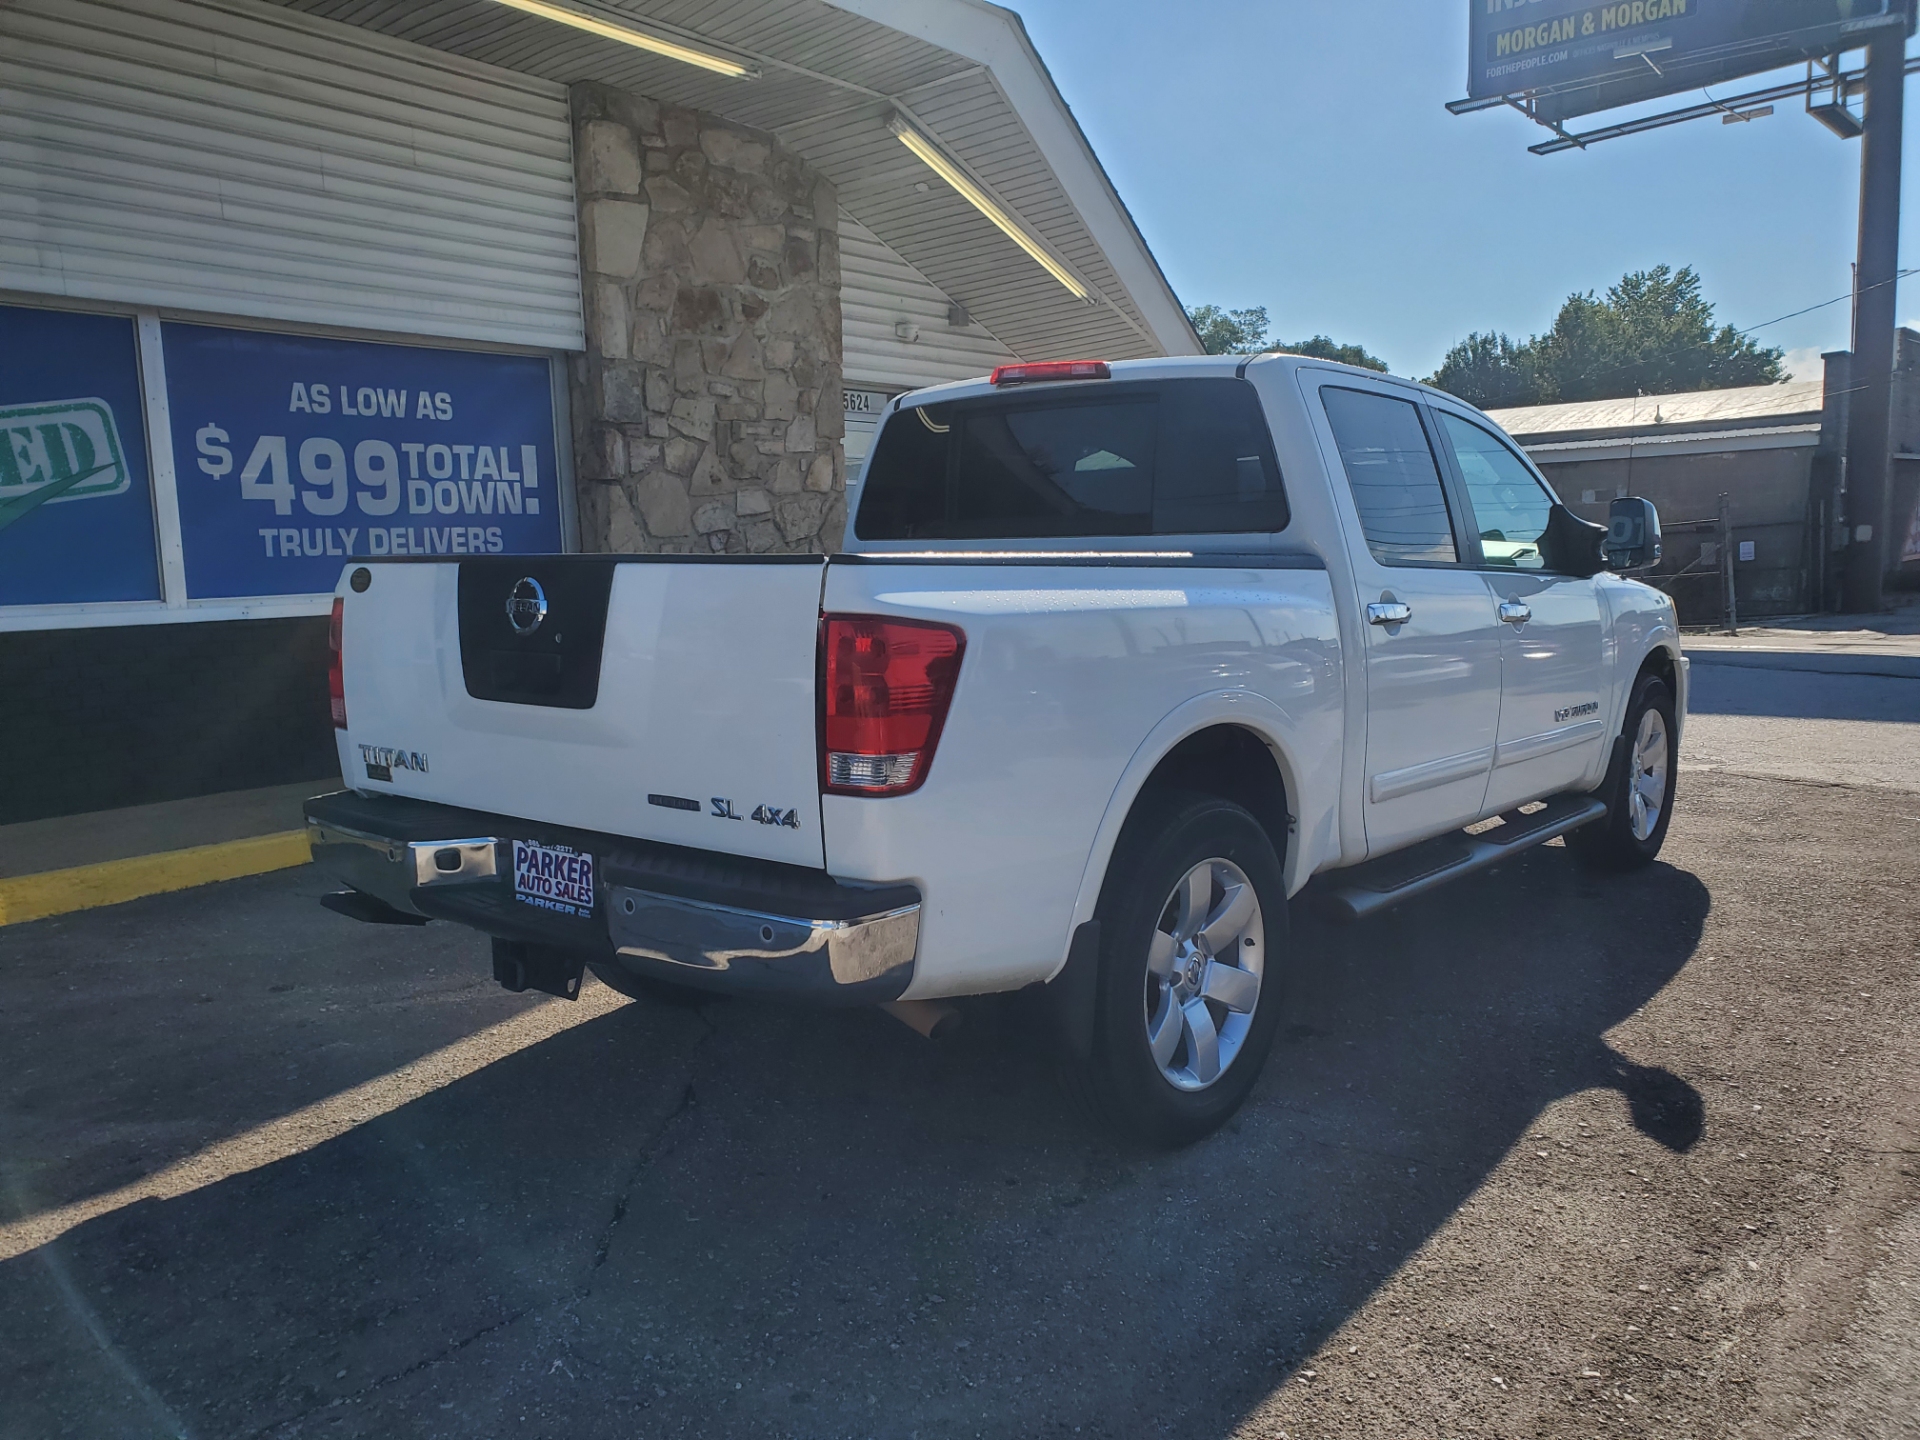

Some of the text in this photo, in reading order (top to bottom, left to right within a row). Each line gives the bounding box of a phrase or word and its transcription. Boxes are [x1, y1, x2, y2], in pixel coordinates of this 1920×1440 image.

[1496, 0, 1686, 57] MORGAN & MORGAN
[1486, 50, 1568, 78] FORTHEPEOPLE.COM
[289, 382, 453, 421] AS LOW AS
[843, 393, 869, 411] 5624
[259, 527, 504, 557] TRULY DELIVERS
[358, 744, 429, 773] TITAN
[710, 797, 744, 821] SL
[516, 846, 592, 887] PARKER
[518, 873, 592, 904] AUTO SALES
[515, 893, 576, 915] PARKER
